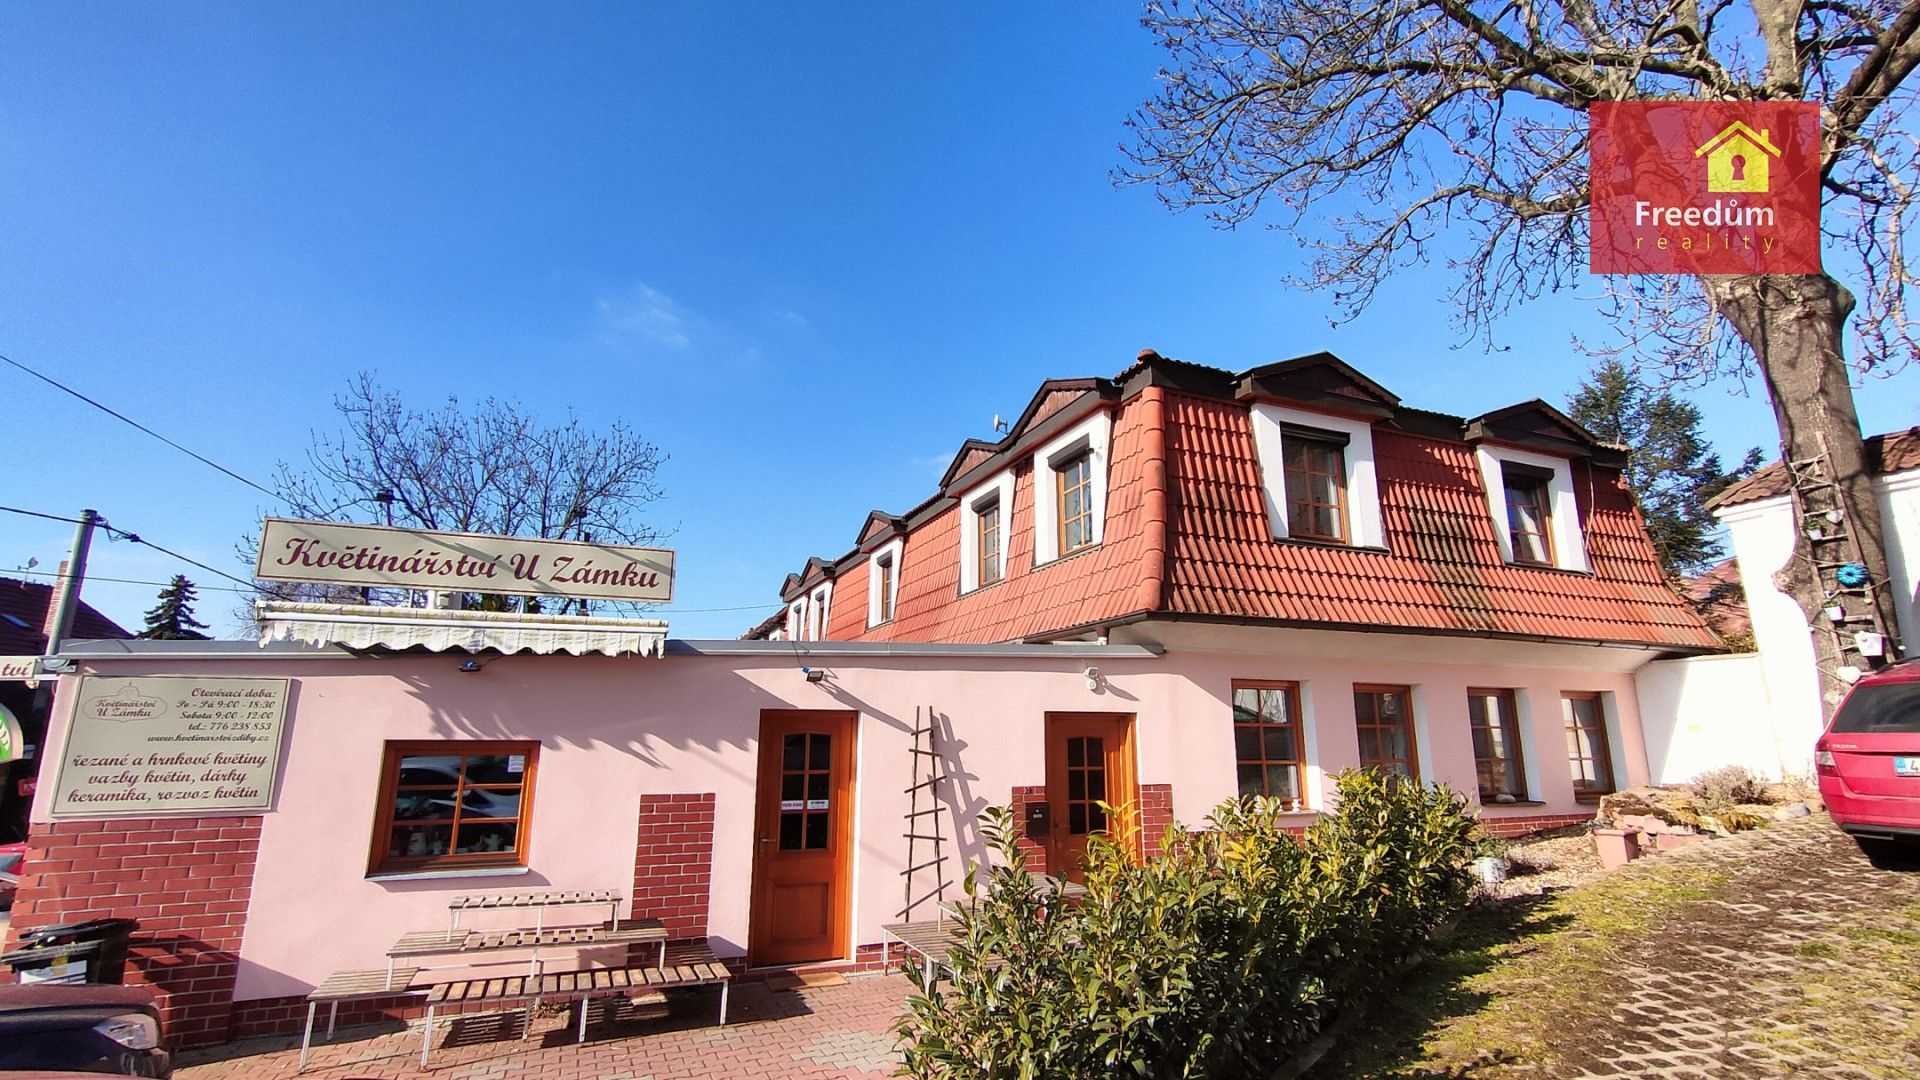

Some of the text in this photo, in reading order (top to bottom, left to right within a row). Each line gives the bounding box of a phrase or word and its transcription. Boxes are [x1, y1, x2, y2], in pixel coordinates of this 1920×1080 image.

[277, 537, 661, 588] Květinářství U Zámku
[191, 687, 278, 698] Otevírací doba:
[176, 700, 190, 708] Po
[199, 700, 214, 709] Pá
[217, 700, 240, 709] 9:00
[249, 700, 276, 709] 18:30
[96, 708, 152, 717] U Zámku
[180, 711, 212, 720] Sobota
[215, 711, 238, 720] 9:00
[247, 711, 274, 720] 12:00
[209, 722, 229, 731] 776
[231, 722, 250, 731] 238
[253, 722, 273, 731] 853
[73, 752, 267, 768] řezané a hrnkové květiny
[88, 769, 248, 787] vazby květin, dárky
[67, 786, 260, 803] keramika, rozvoz květin
